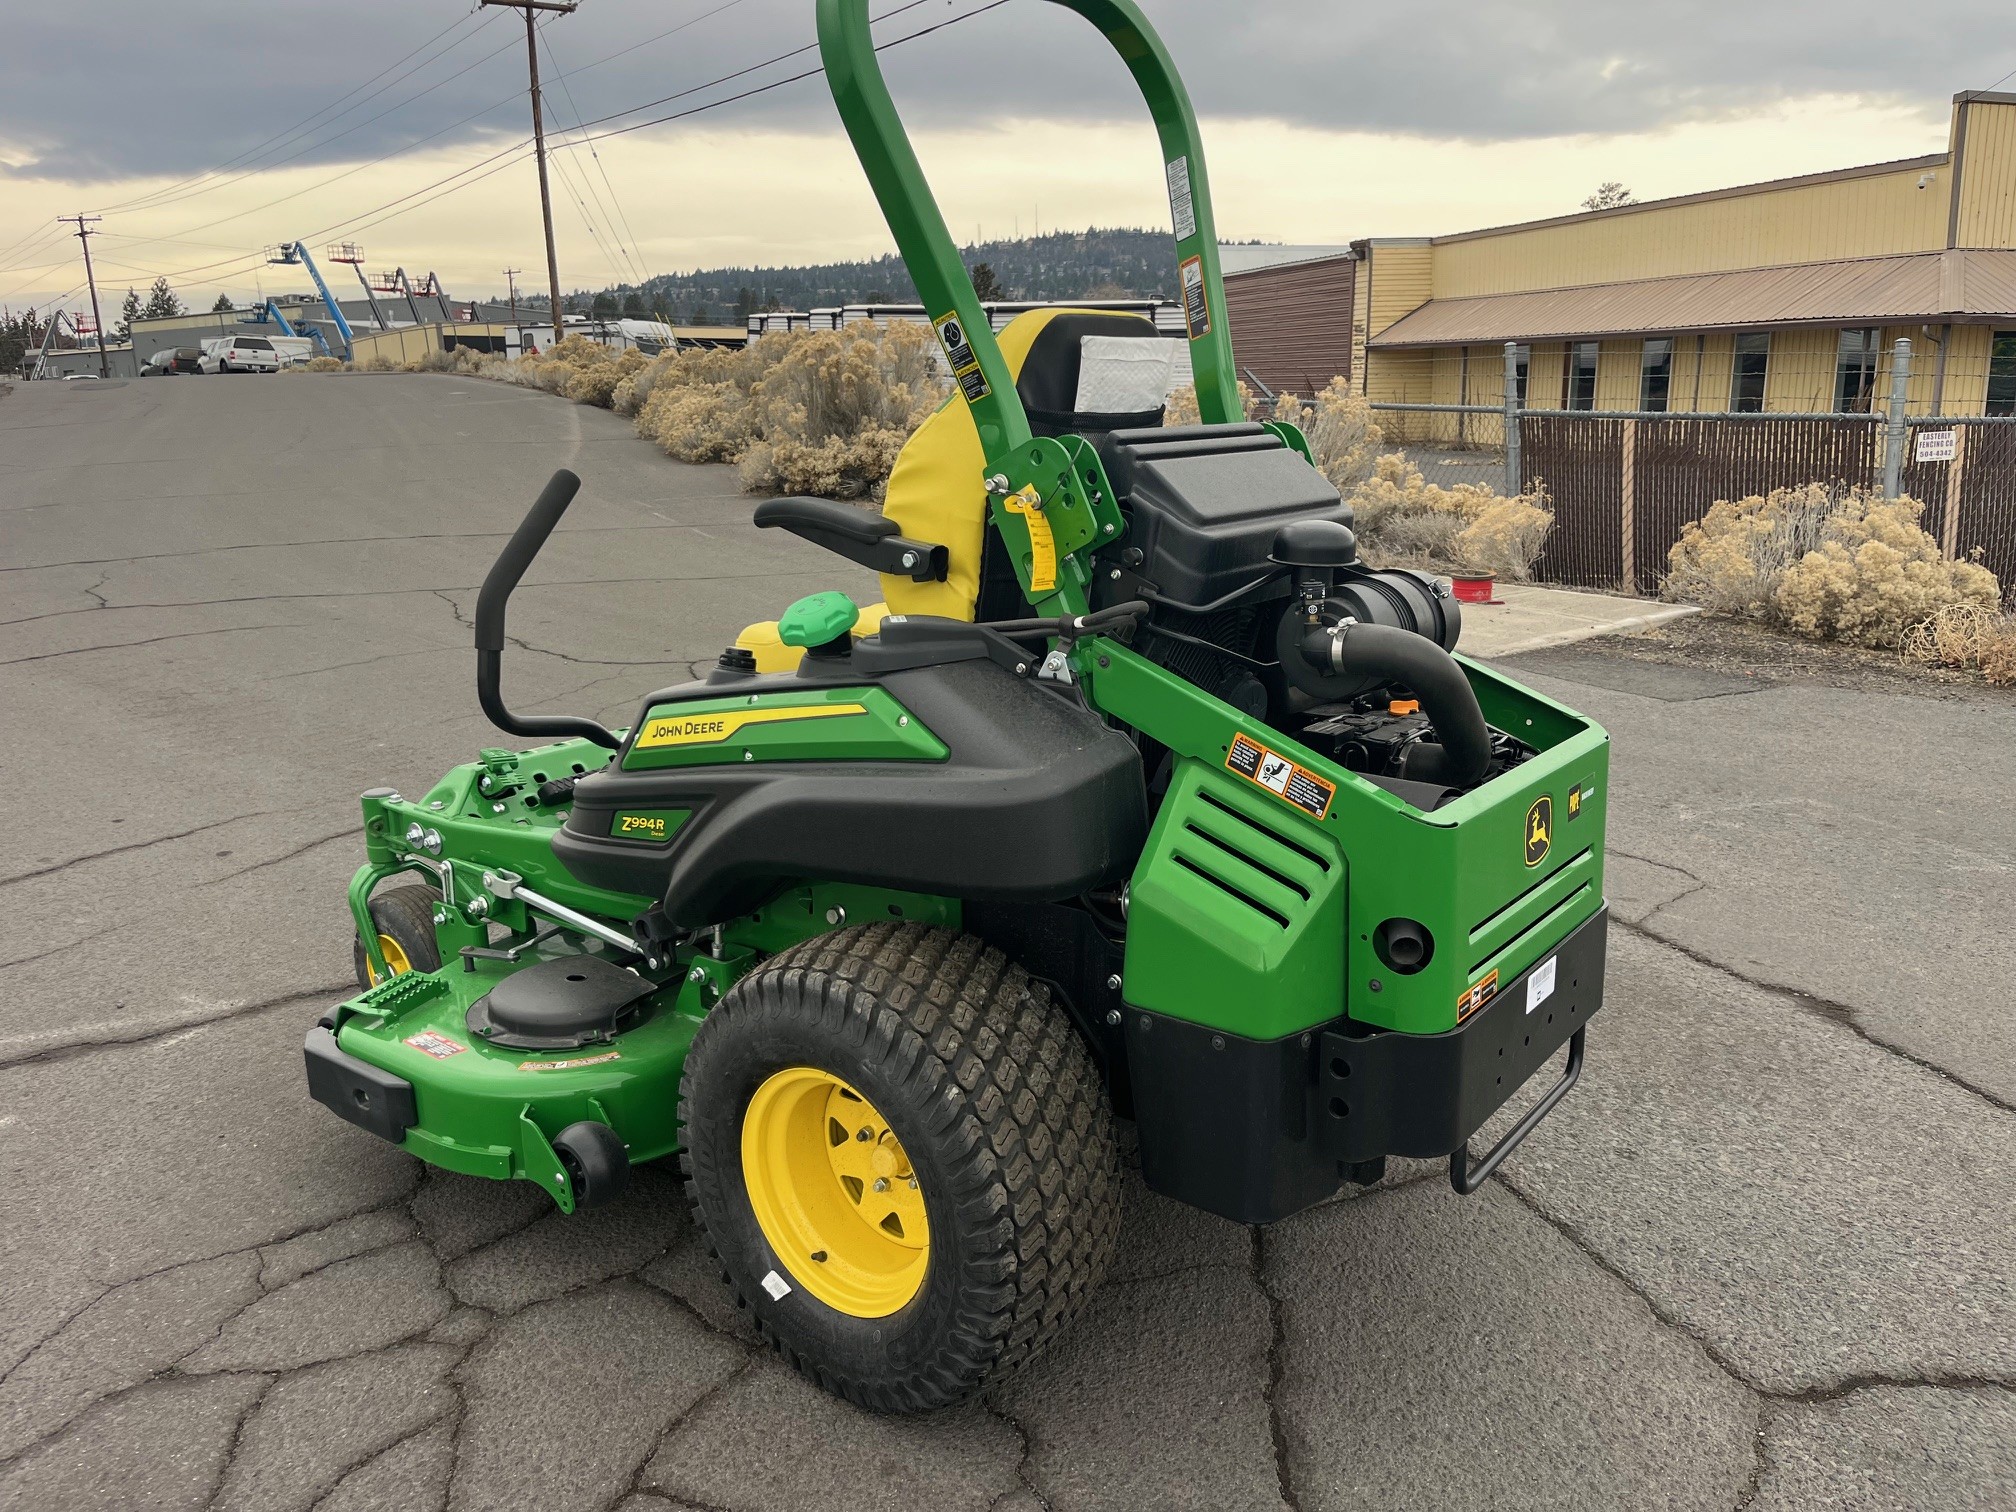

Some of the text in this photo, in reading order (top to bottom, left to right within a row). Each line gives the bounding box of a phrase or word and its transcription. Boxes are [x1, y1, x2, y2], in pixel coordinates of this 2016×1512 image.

[1919, 440, 1944, 448] FENCING
[652, 721, 724, 738] JOHN DEERE
[1244, 738, 1263, 751] WARNING
[1303, 769, 1331, 788] ADVERTENCIA
[621, 816, 665, 831] Z994R
